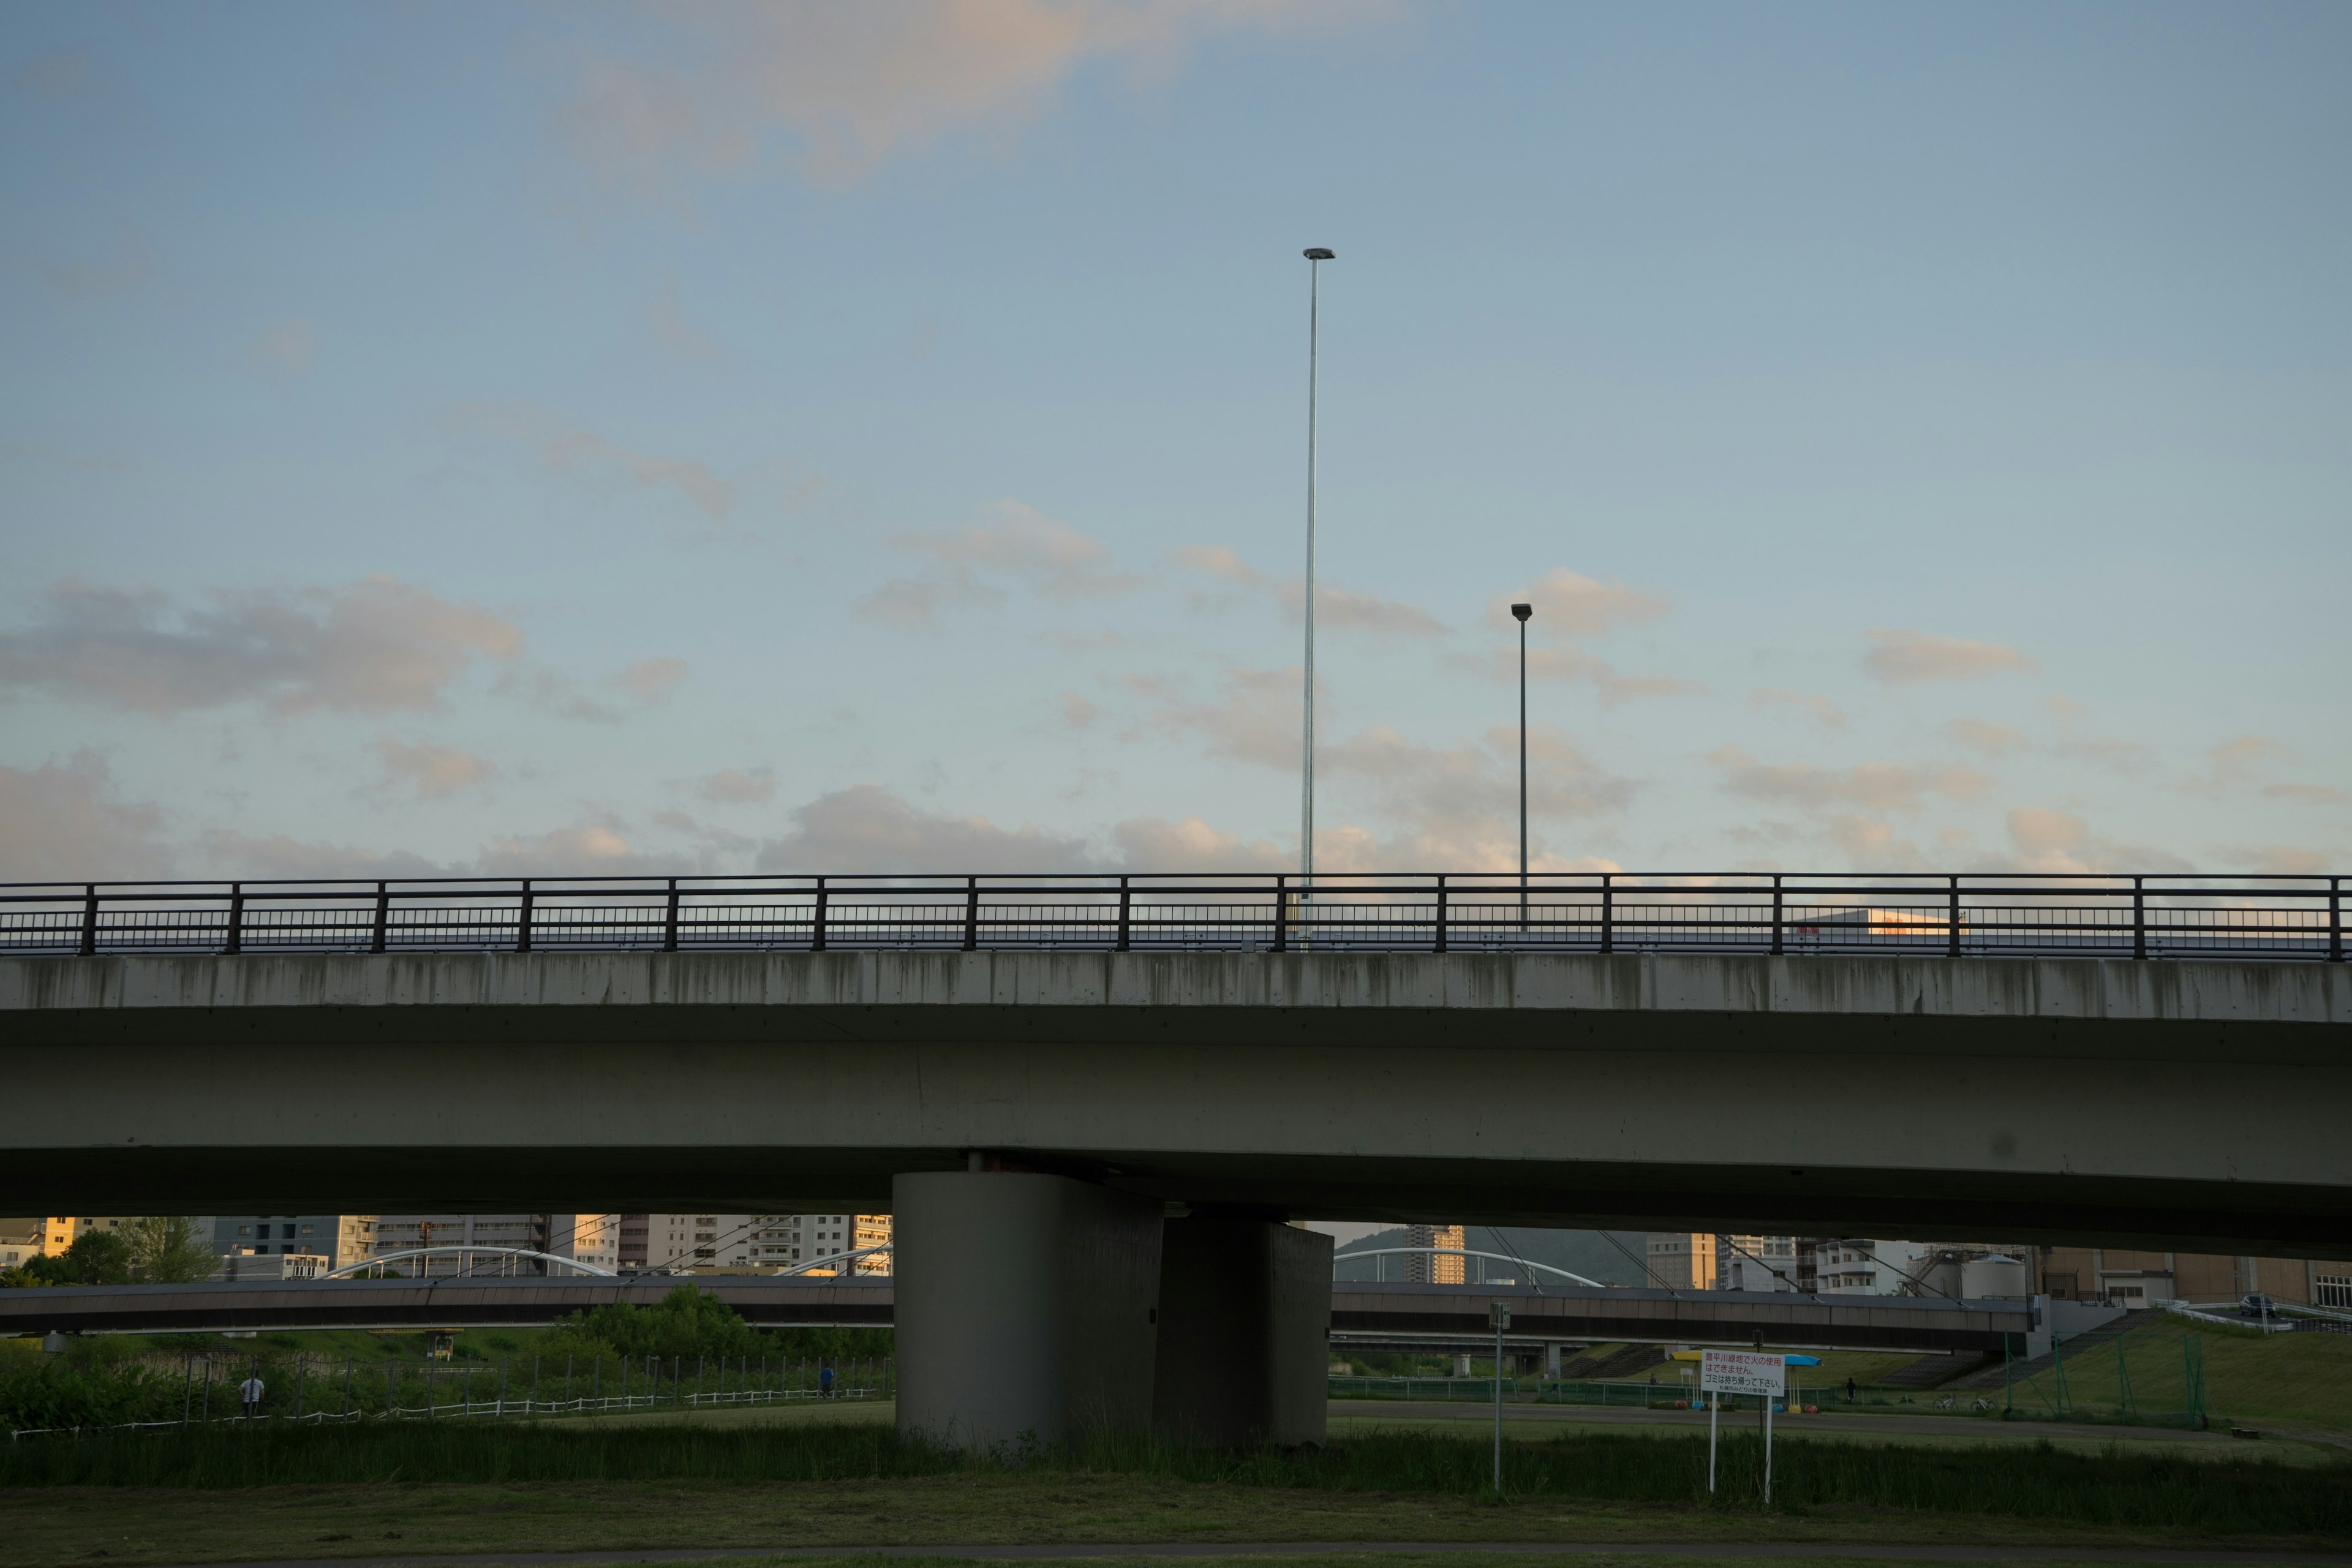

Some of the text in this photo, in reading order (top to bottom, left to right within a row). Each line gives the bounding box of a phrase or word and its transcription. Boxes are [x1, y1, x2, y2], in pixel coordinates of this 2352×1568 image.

[1706, 1352, 1781, 1366] 豊平川緑地で火の使用
[1706, 1363, 1754, 1375] はできません。
[1705, 1374, 1781, 1389] ゴミは持ち帰って下さい。
